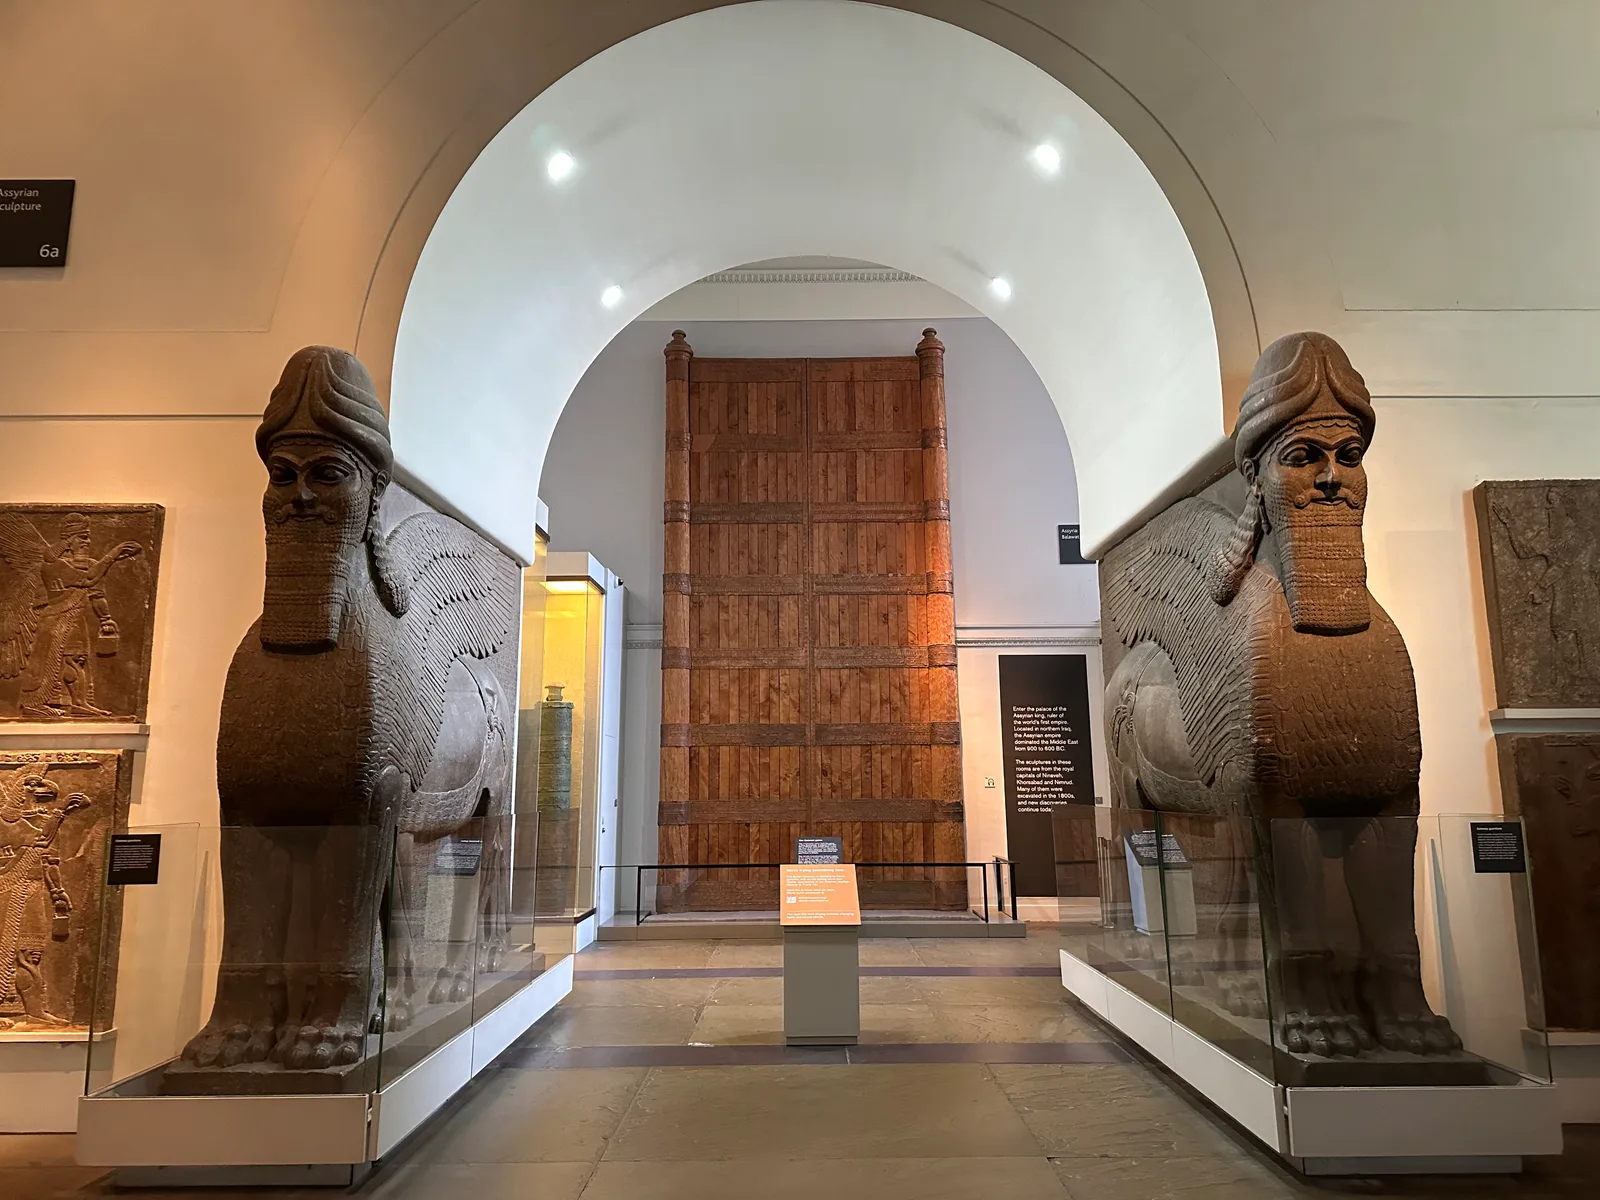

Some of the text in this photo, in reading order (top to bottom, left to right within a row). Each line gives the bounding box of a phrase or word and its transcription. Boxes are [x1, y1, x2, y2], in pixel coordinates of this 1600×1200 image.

[0, 188, 39, 199] Assyrian
[0, 202, 42, 213] culpture
[40, 244, 60, 258] 6a
